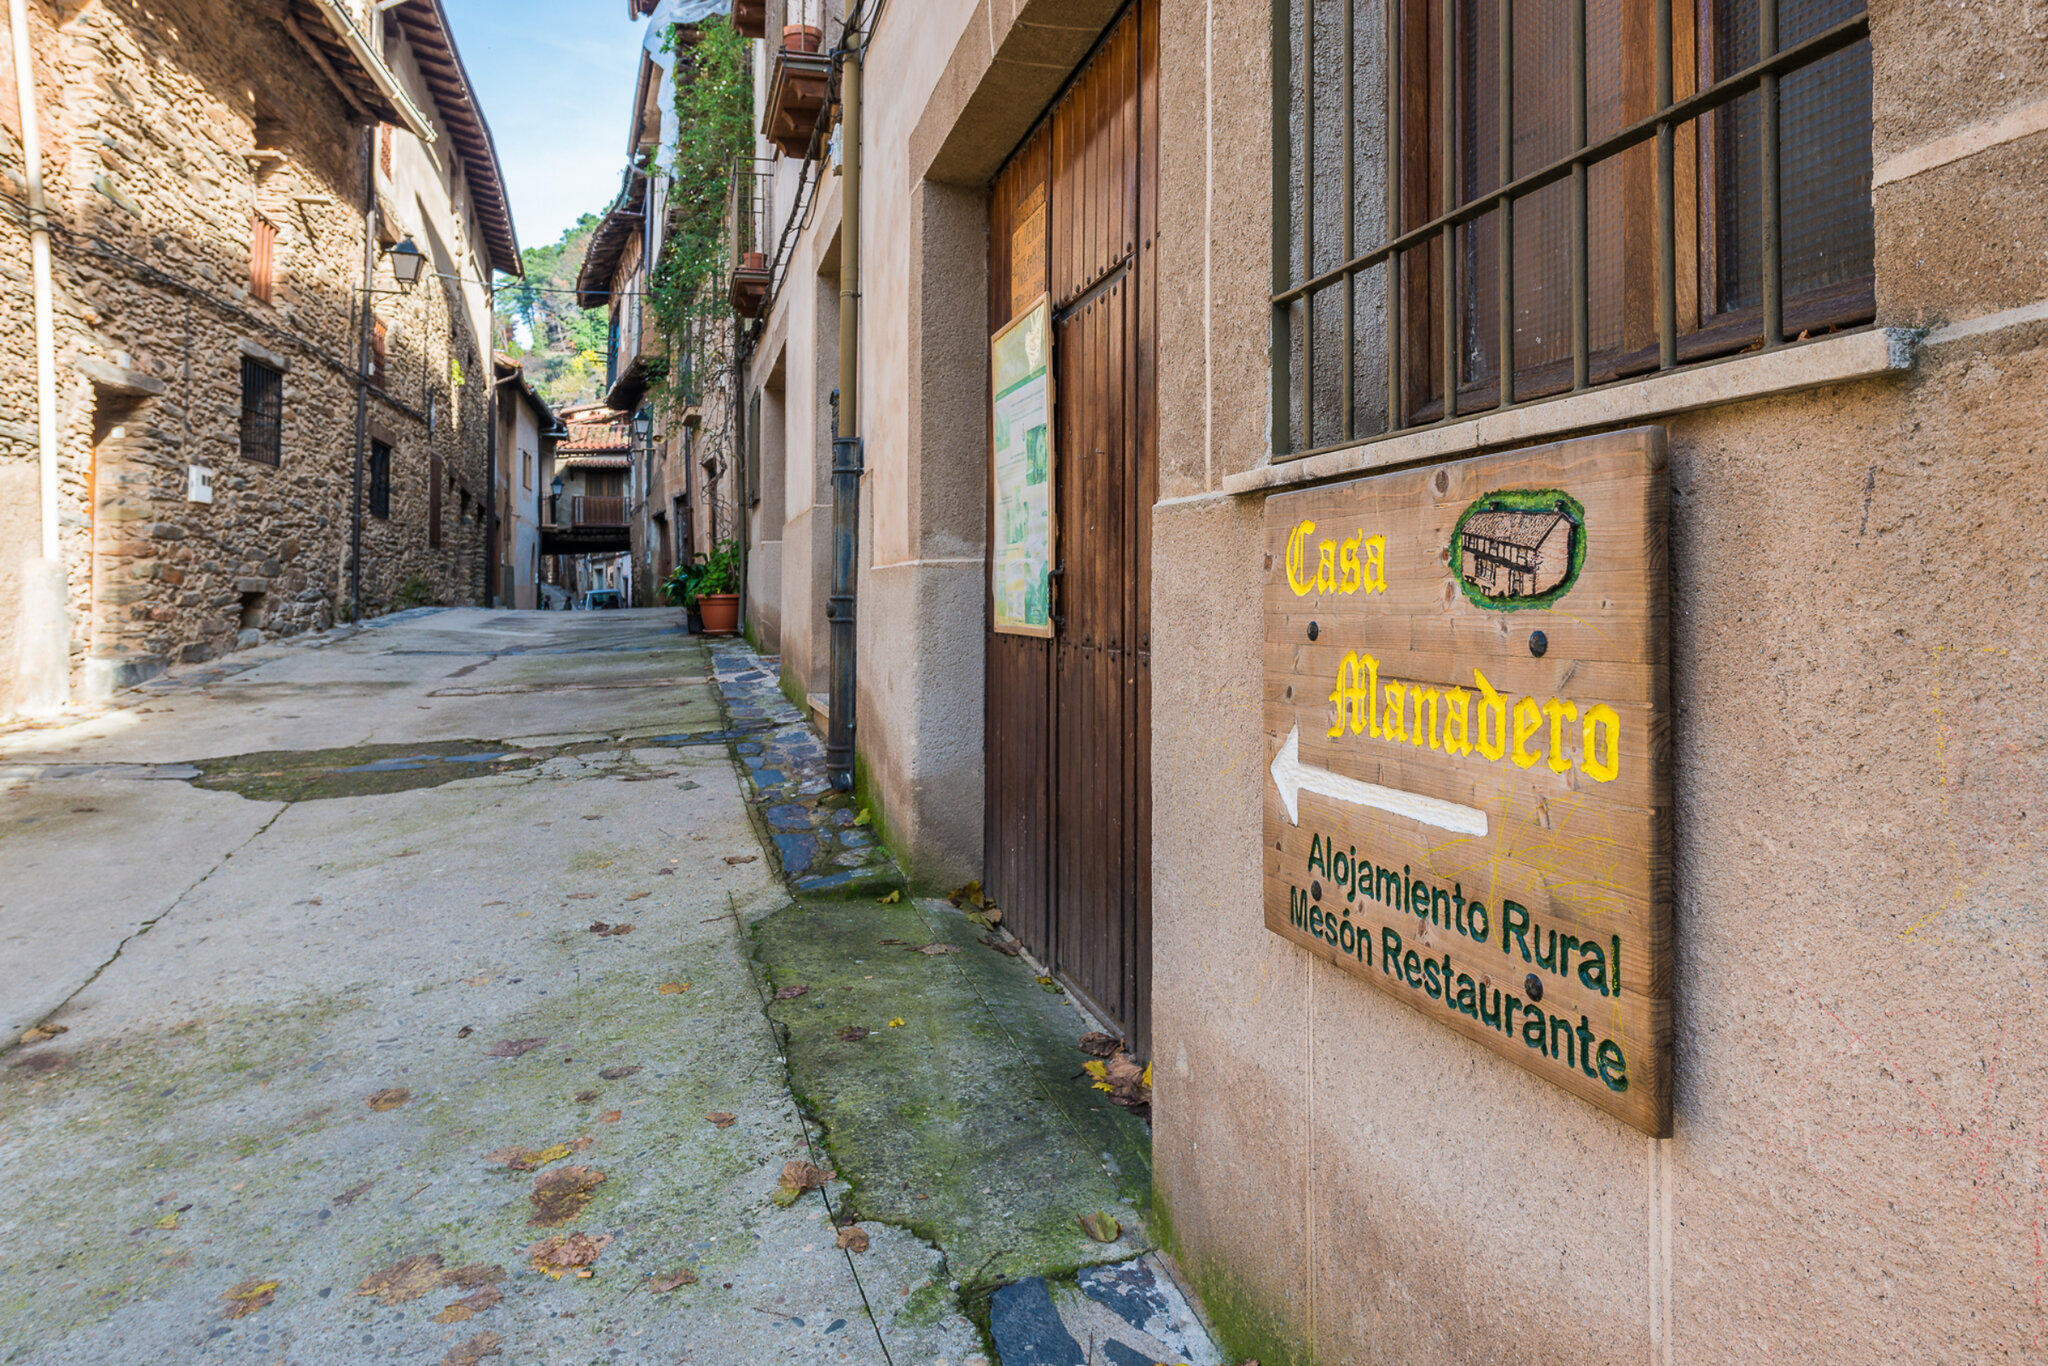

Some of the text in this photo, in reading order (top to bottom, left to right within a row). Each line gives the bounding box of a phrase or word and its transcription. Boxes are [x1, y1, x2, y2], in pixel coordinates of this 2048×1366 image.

[1286, 519, 1388, 597] Casa
[1326, 650, 1620, 783] Manadero
[1290, 886, 1629, 1093] Mesón Restaurante
[1308, 833, 1621, 998] Alojamiento Rural
